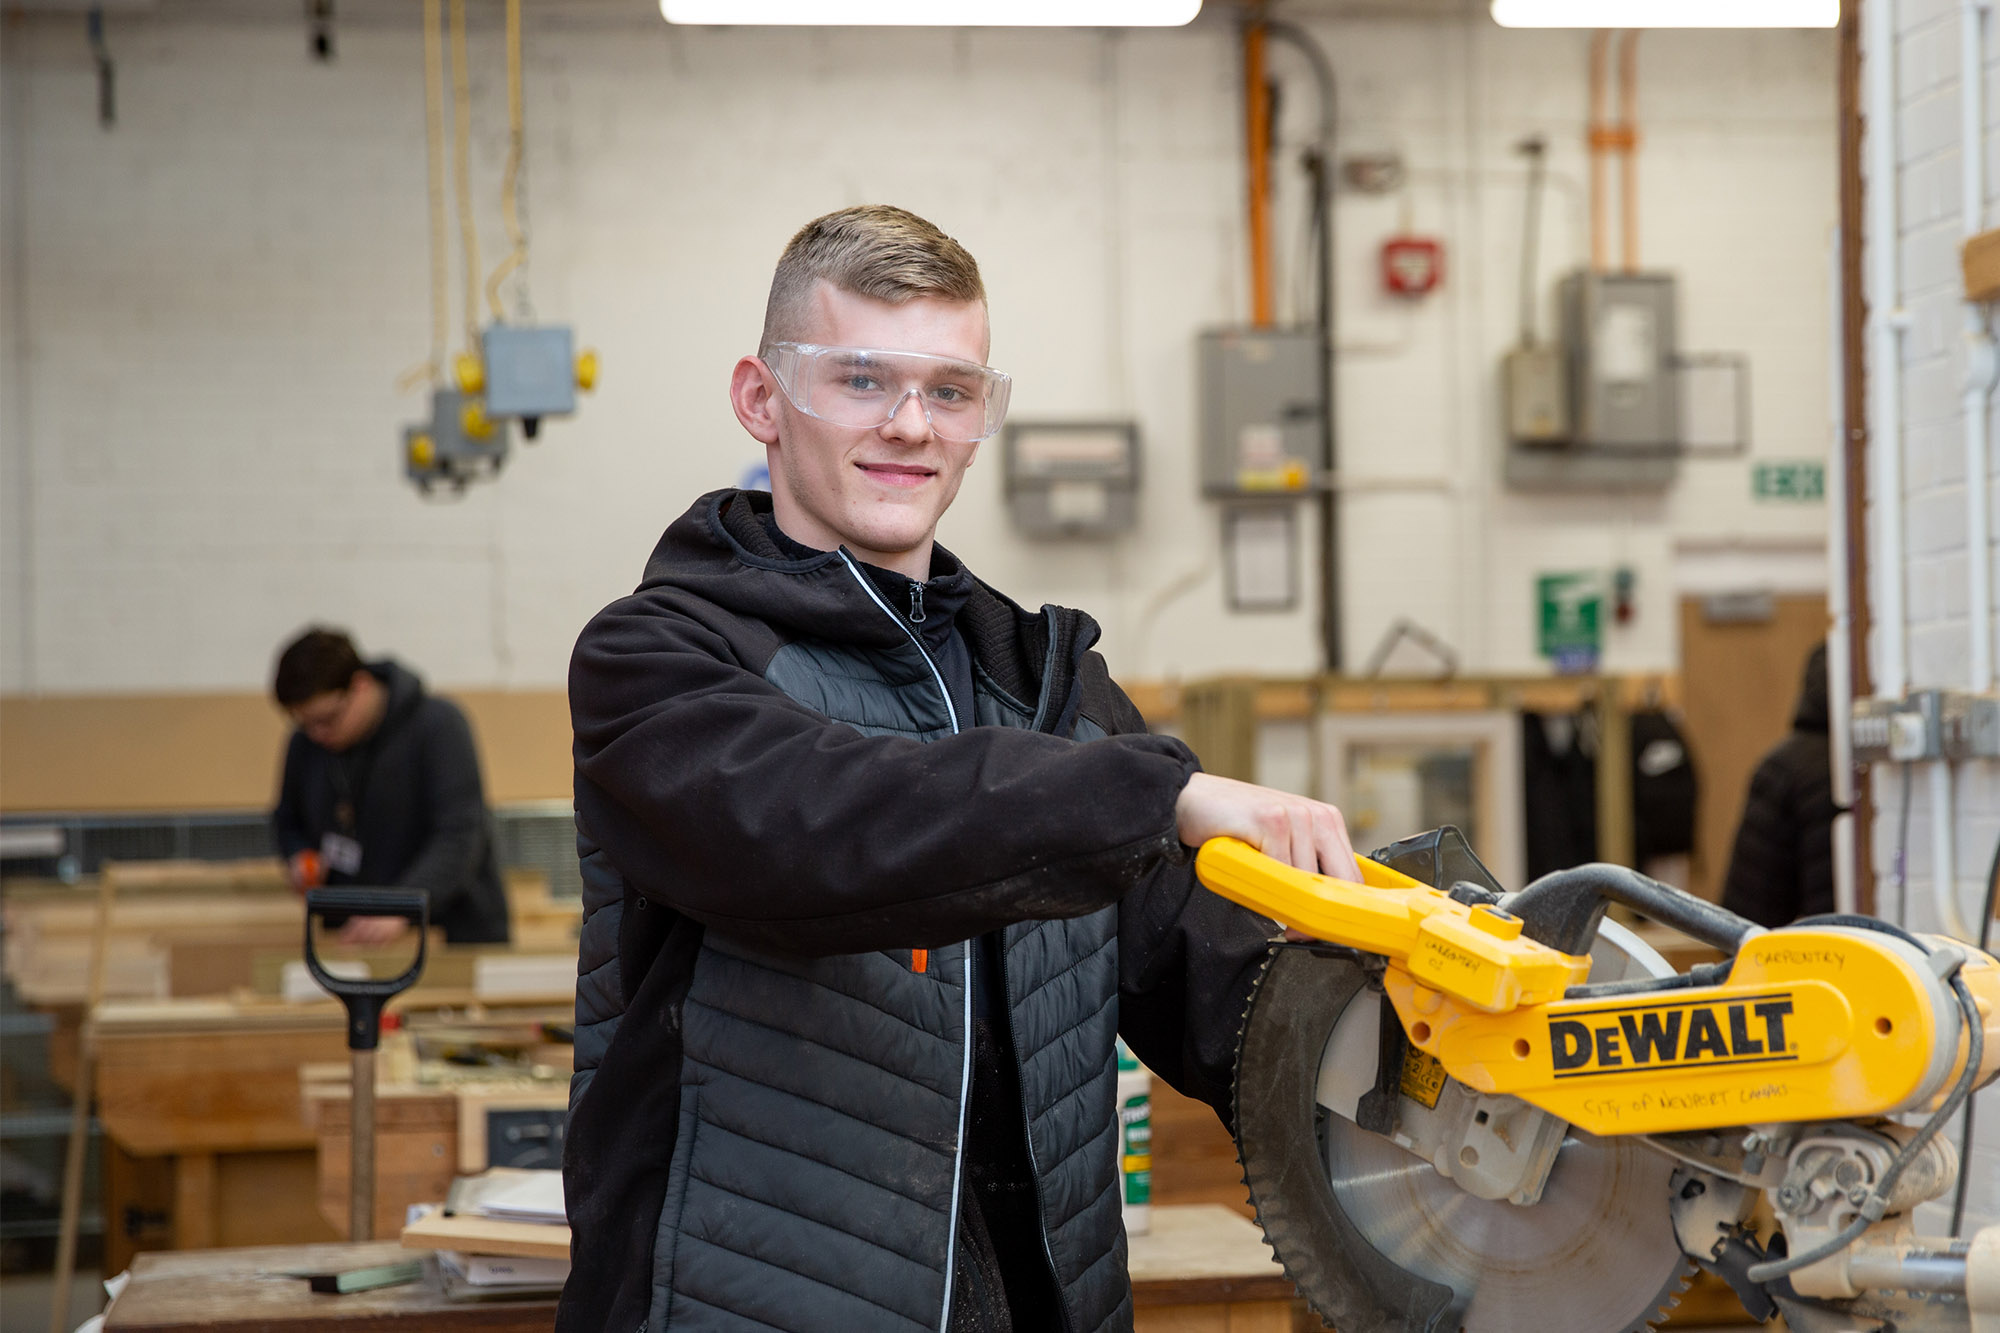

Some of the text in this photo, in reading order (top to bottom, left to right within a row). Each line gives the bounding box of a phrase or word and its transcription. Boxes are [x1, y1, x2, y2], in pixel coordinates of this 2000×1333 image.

[1755, 949, 1845, 972] CARPENTRY
[1584, 1099, 1621, 1119] CITY
[1660, 1088, 1729, 1109] NEWPORT
